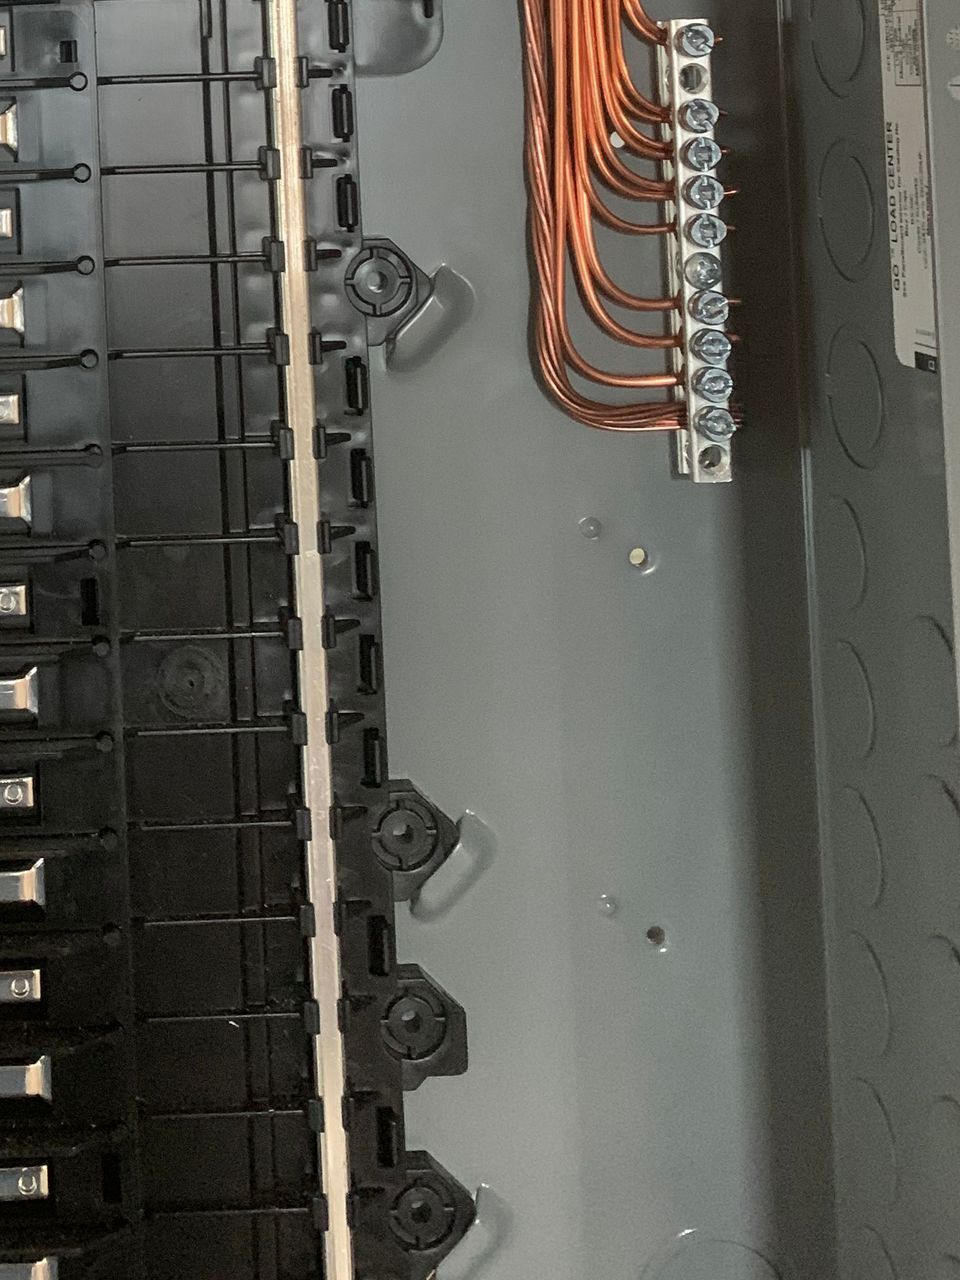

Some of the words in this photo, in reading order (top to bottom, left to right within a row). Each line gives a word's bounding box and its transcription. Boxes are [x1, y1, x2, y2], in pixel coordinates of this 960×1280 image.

[886, 122, 895, 189] CENTER
[889, 195, 898, 243] LOAD
[892, 265, 899, 291] QO
